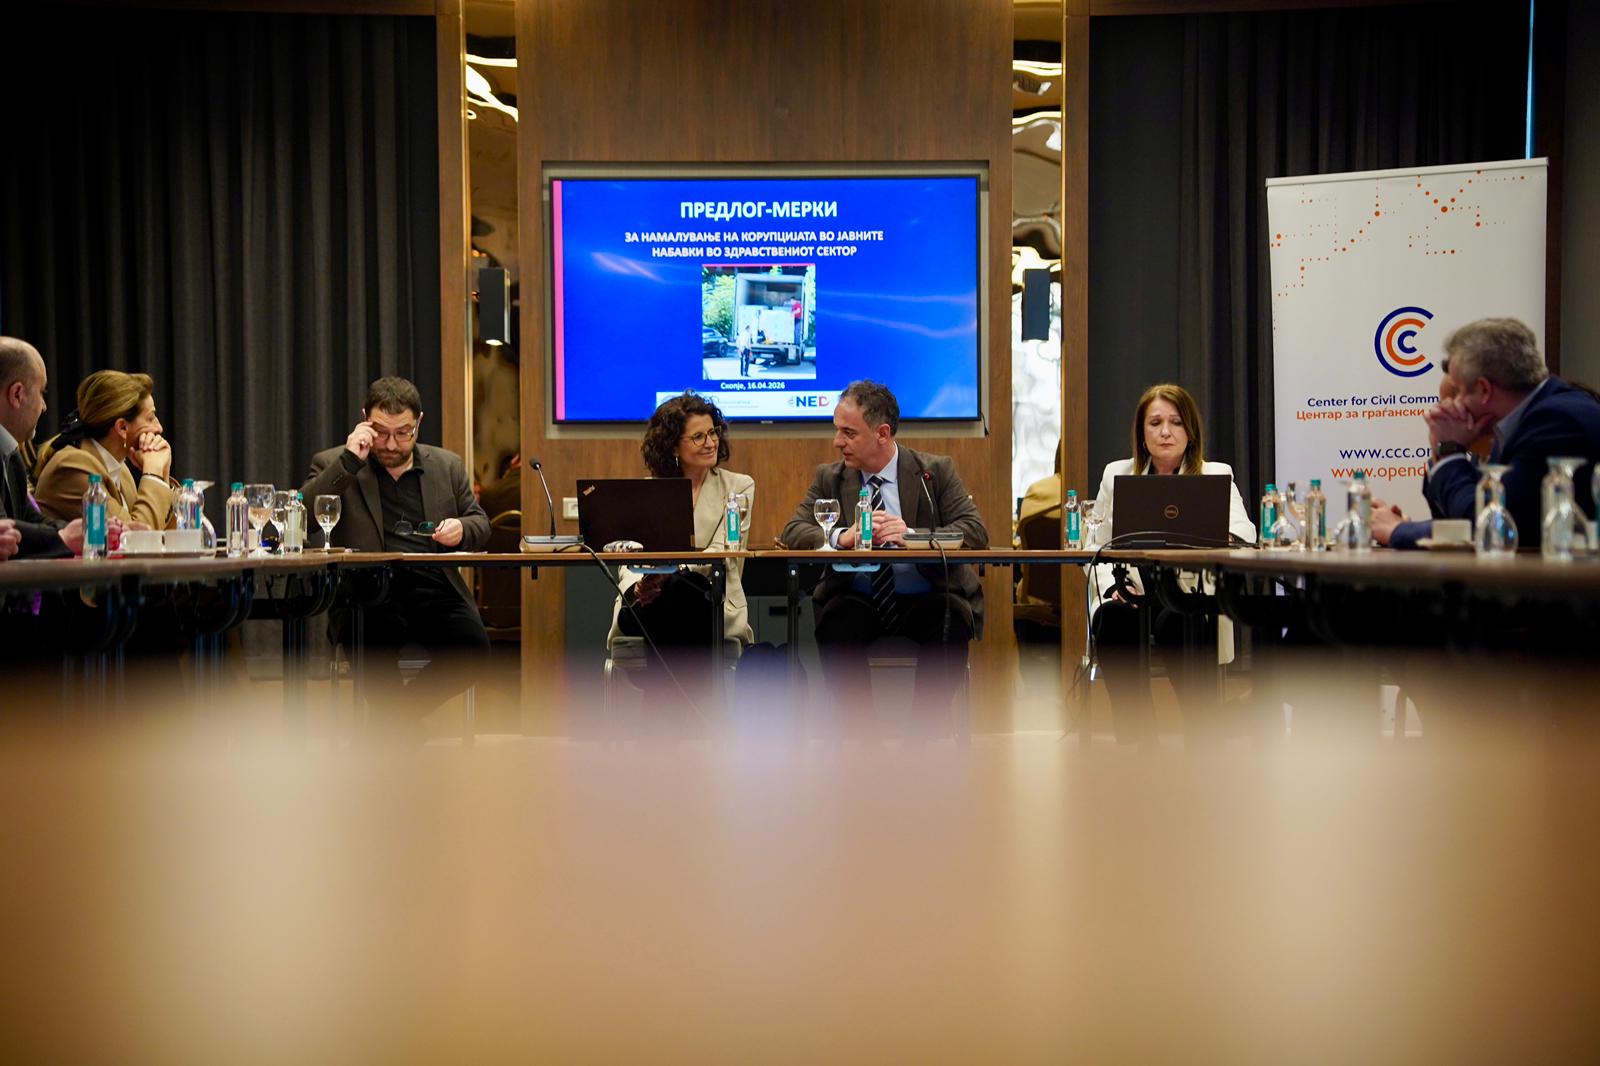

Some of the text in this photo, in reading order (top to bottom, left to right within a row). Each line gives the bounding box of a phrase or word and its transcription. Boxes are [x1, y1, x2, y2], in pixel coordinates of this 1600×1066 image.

[680, 201, 838, 221] ПРЕДЛОГ-МЕРКИ
[625, 230, 884, 244] ЗА НАМАЛУВАЊЕ НА КОРУПЦИЈАТА ВО ЈАВНИТЕ
[652, 245, 857, 259] НАБАВКИ ВО ЗДРАВСТВЕНИОТ СЕКТОР
[747, 381, 786, 390] 16.04.2026
[1307, 394, 1439, 408] Center for Civil Comm
[1296, 407, 1425, 421] Центар за граѓански
[1339, 447, 1432, 459] www.ccc.or
[1331, 463, 1427, 481] www.opend
